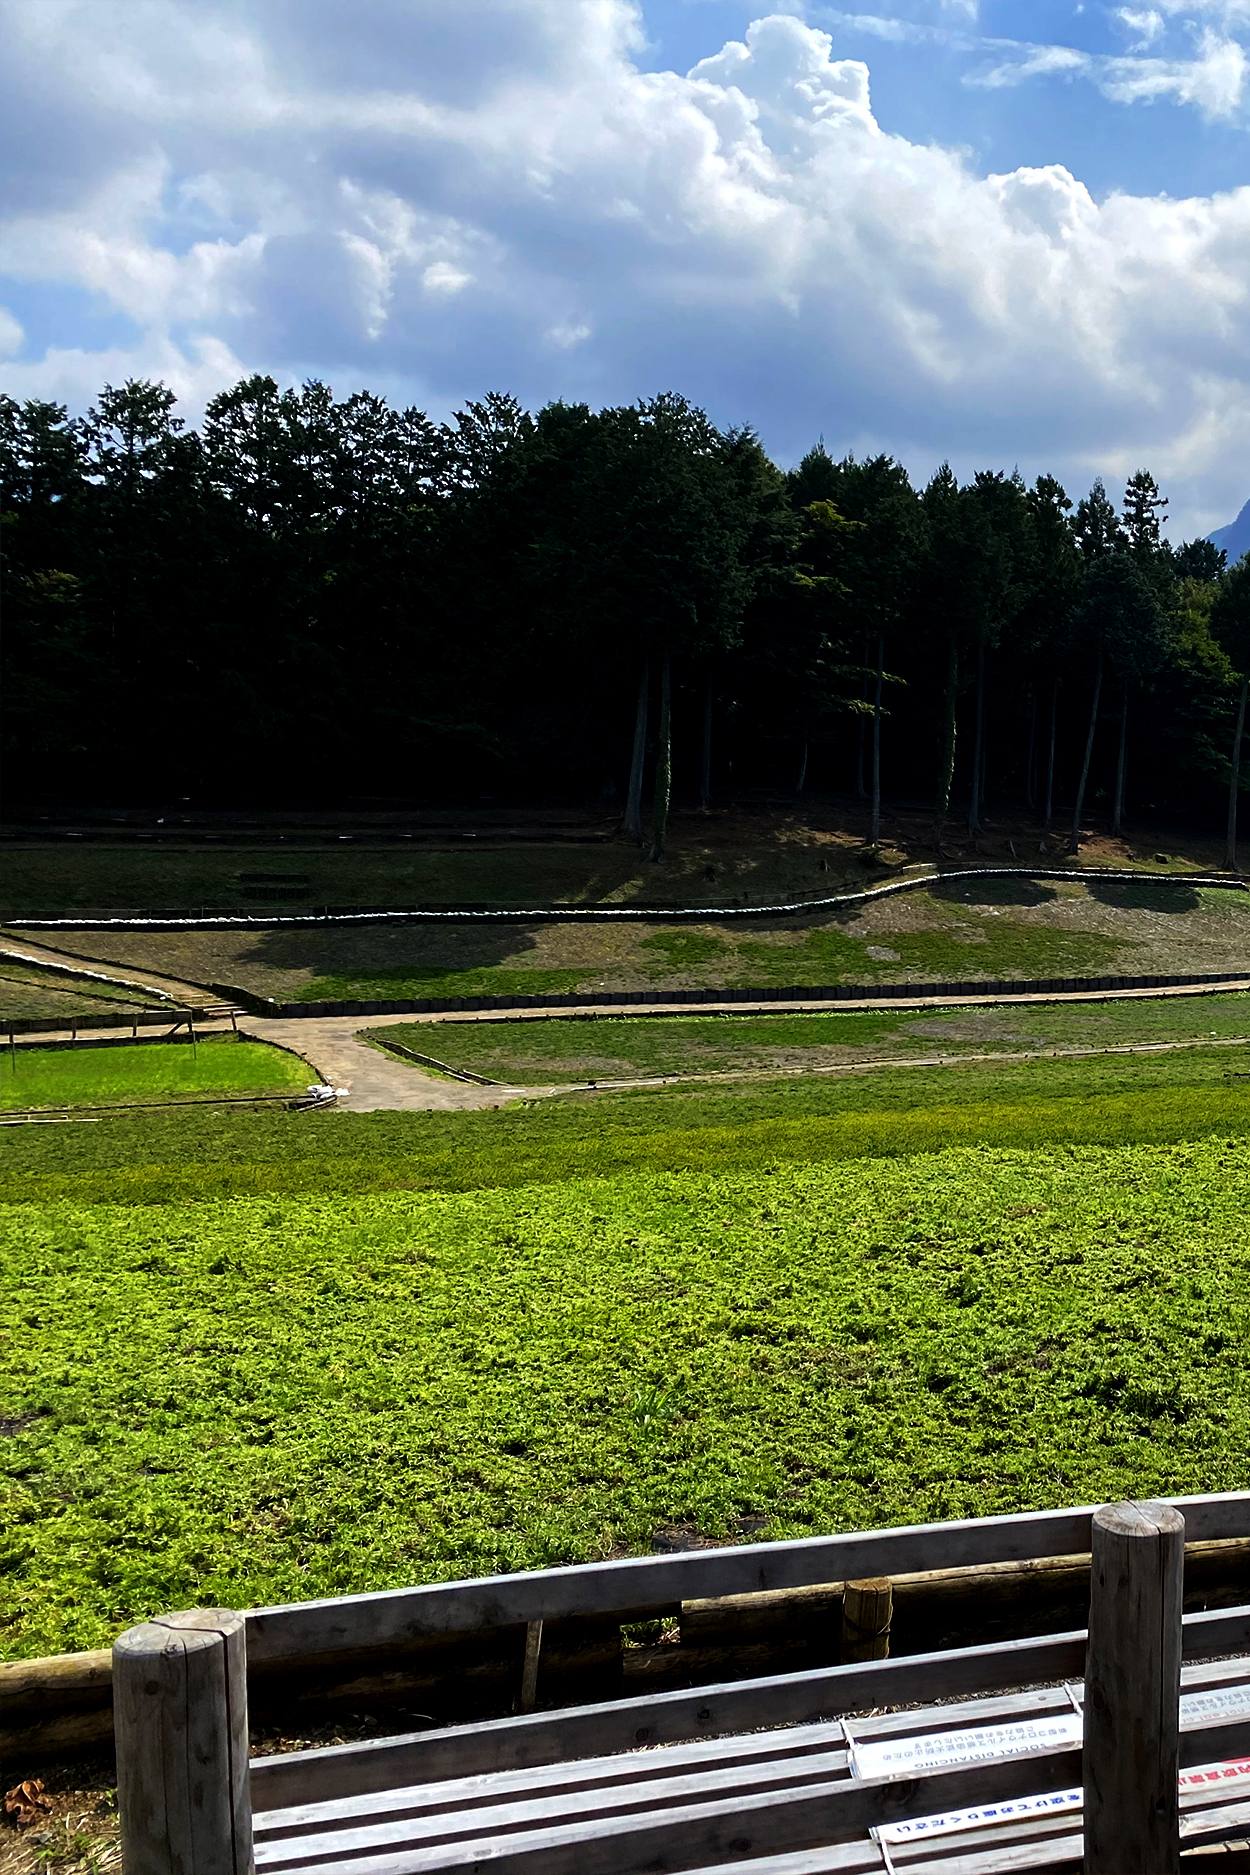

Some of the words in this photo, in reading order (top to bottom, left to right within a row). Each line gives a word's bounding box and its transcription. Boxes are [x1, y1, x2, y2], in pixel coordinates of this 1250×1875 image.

[882, 1727, 1068, 1762] 新型コロナウイルス感染拡大防止のため
[913, 1726, 1035, 1750] ご協力をお願いいたします
[913, 1751, 995, 1769] DISTANCING
[895, 1794, 1082, 1835] を空けてお座りください
